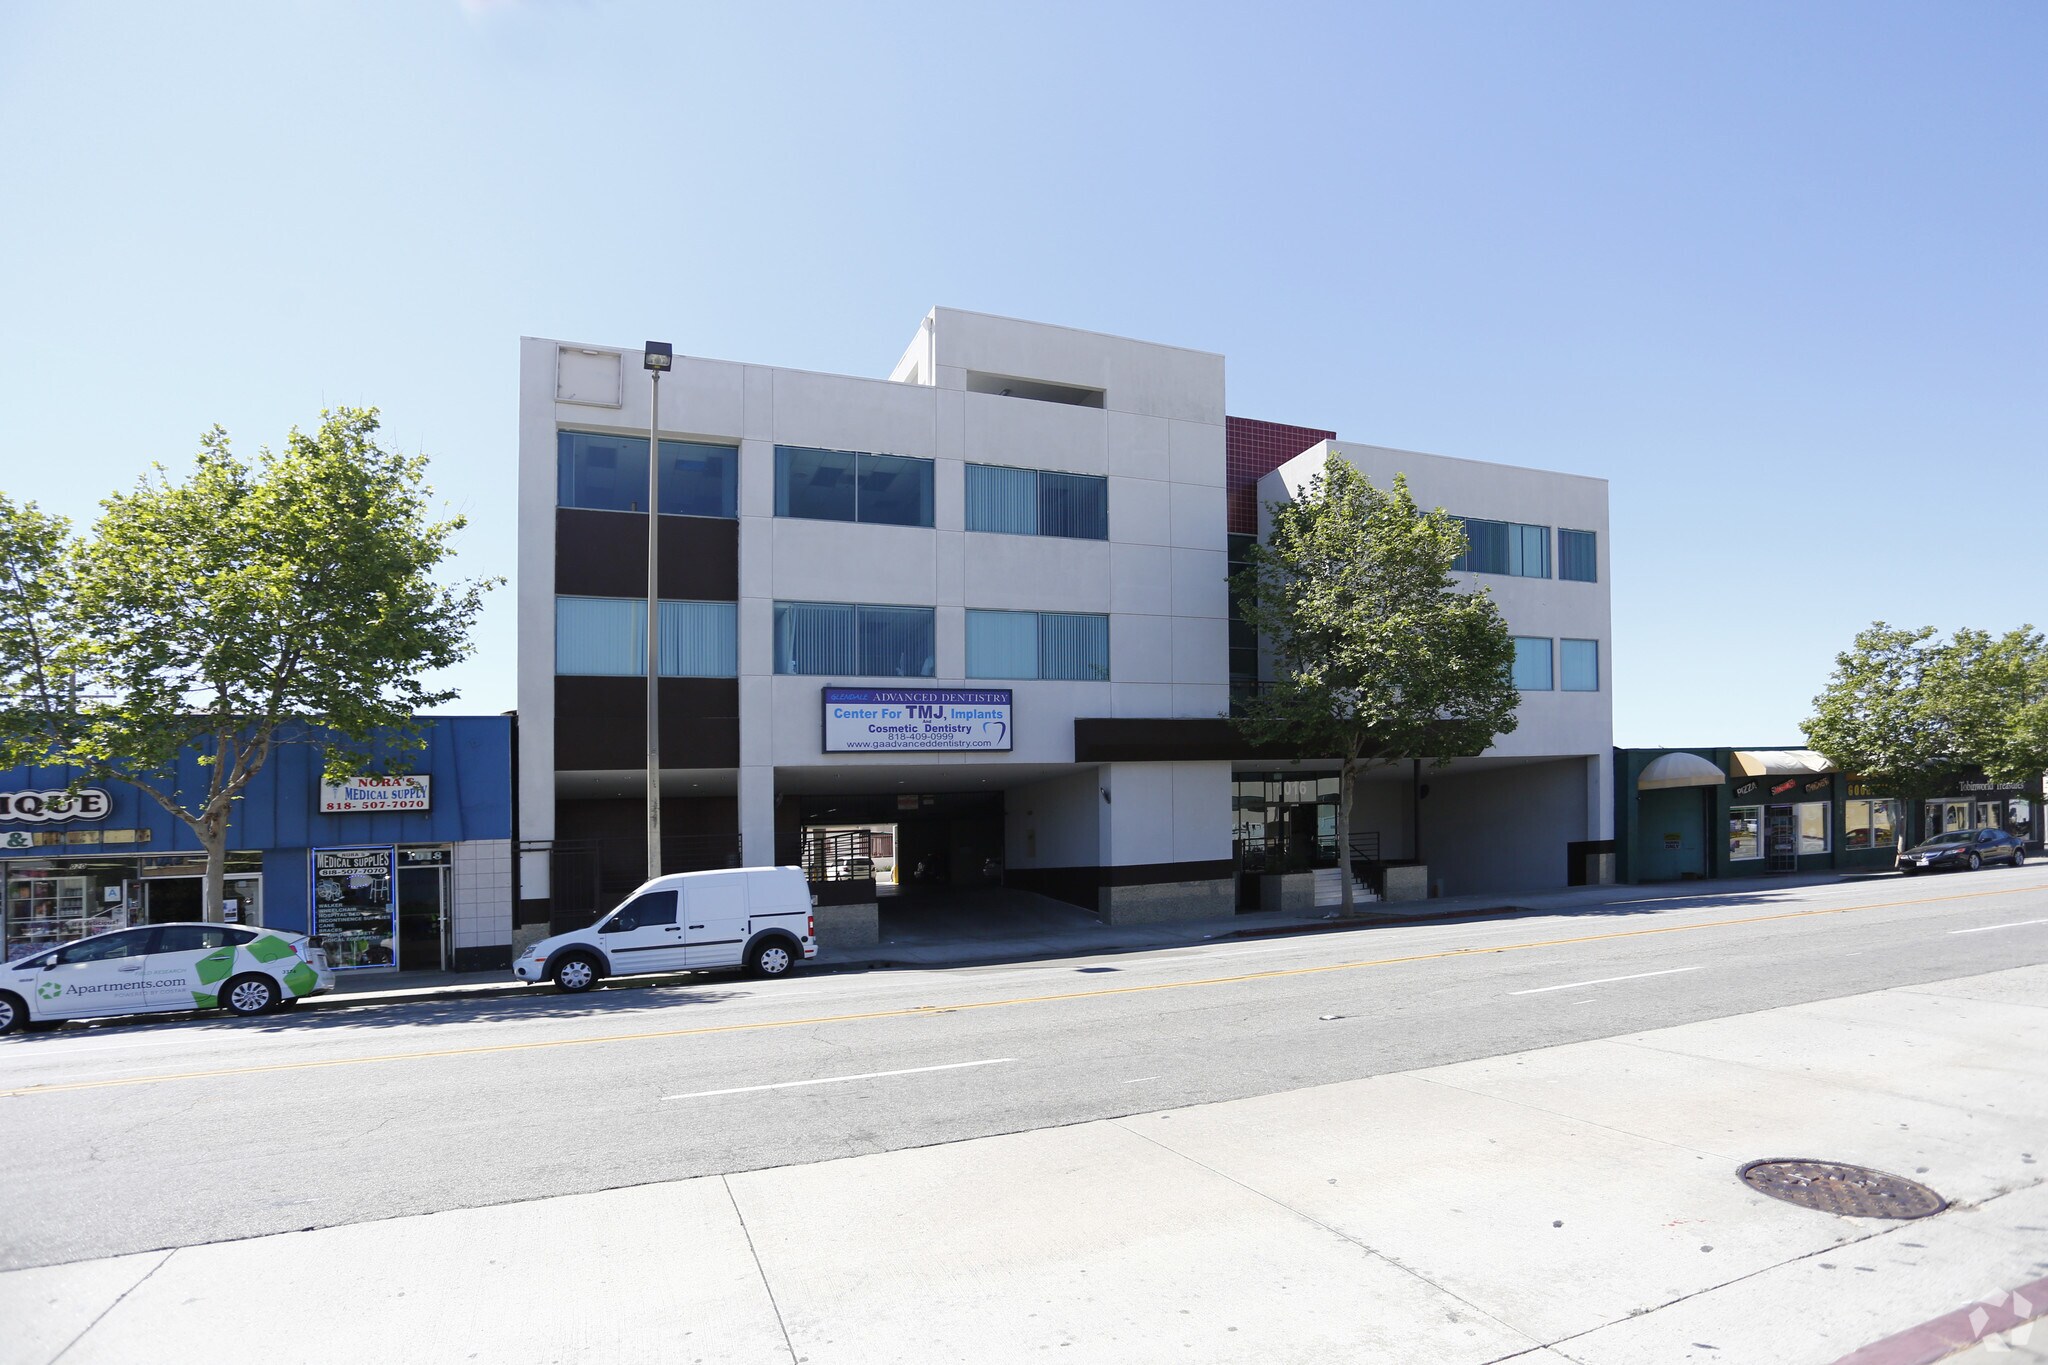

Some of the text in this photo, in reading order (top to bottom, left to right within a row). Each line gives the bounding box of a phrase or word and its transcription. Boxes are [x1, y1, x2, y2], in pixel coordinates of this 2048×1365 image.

[830, 692, 1009, 703] GLENDALE ADVANCED DENTISTRY
[834, 705, 1003, 721] Center For TMJ, Implants
[868, 724, 972, 735] Cosmetic Dentistry
[888, 733, 954, 741] 818-409-0999
[846, 740, 992, 749] www.gaadvanceddentistry.com
[358, 777, 415, 787] NORA'S
[1958, 781, 1994, 791] Tobinworld
[344, 785, 428, 800] MEDICAL SUPPLY
[1736, 781, 1758, 796] PIZZA
[362, 800, 424, 809] 507-7070
[317, 851, 390, 868] MEDICAL SUPPLIES
[322, 868, 385, 876] 818-507-7070
[108, 889, 117, 897] A
[66, 978, 186, 996] Apartments.com
